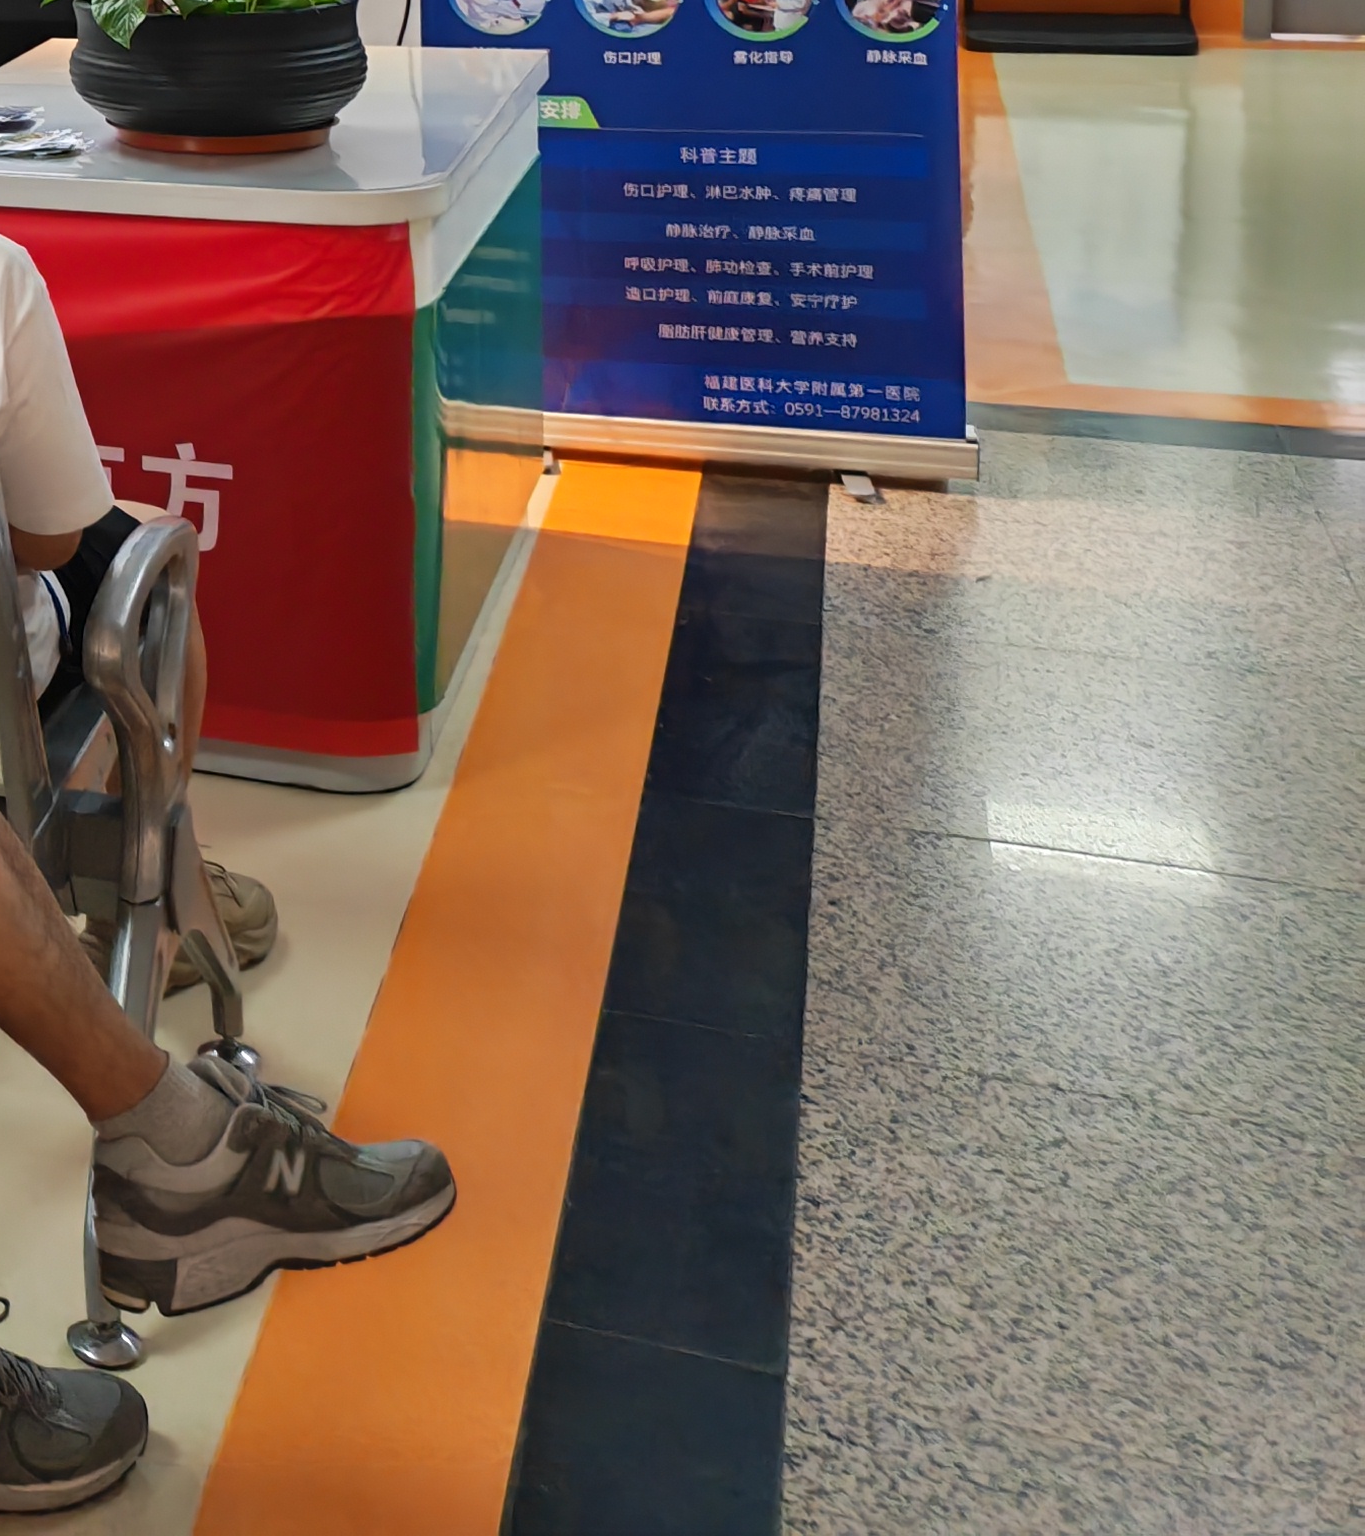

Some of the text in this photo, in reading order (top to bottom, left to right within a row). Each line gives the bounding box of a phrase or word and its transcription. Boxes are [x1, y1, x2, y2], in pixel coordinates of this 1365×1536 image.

[603, 51, 662, 66] 伤口护理
[732, 50, 794, 66] 雾化指导
[679, 147, 758, 166] 科普主题
[704, 374, 921, 402] 福建医科大学附属第一医院
